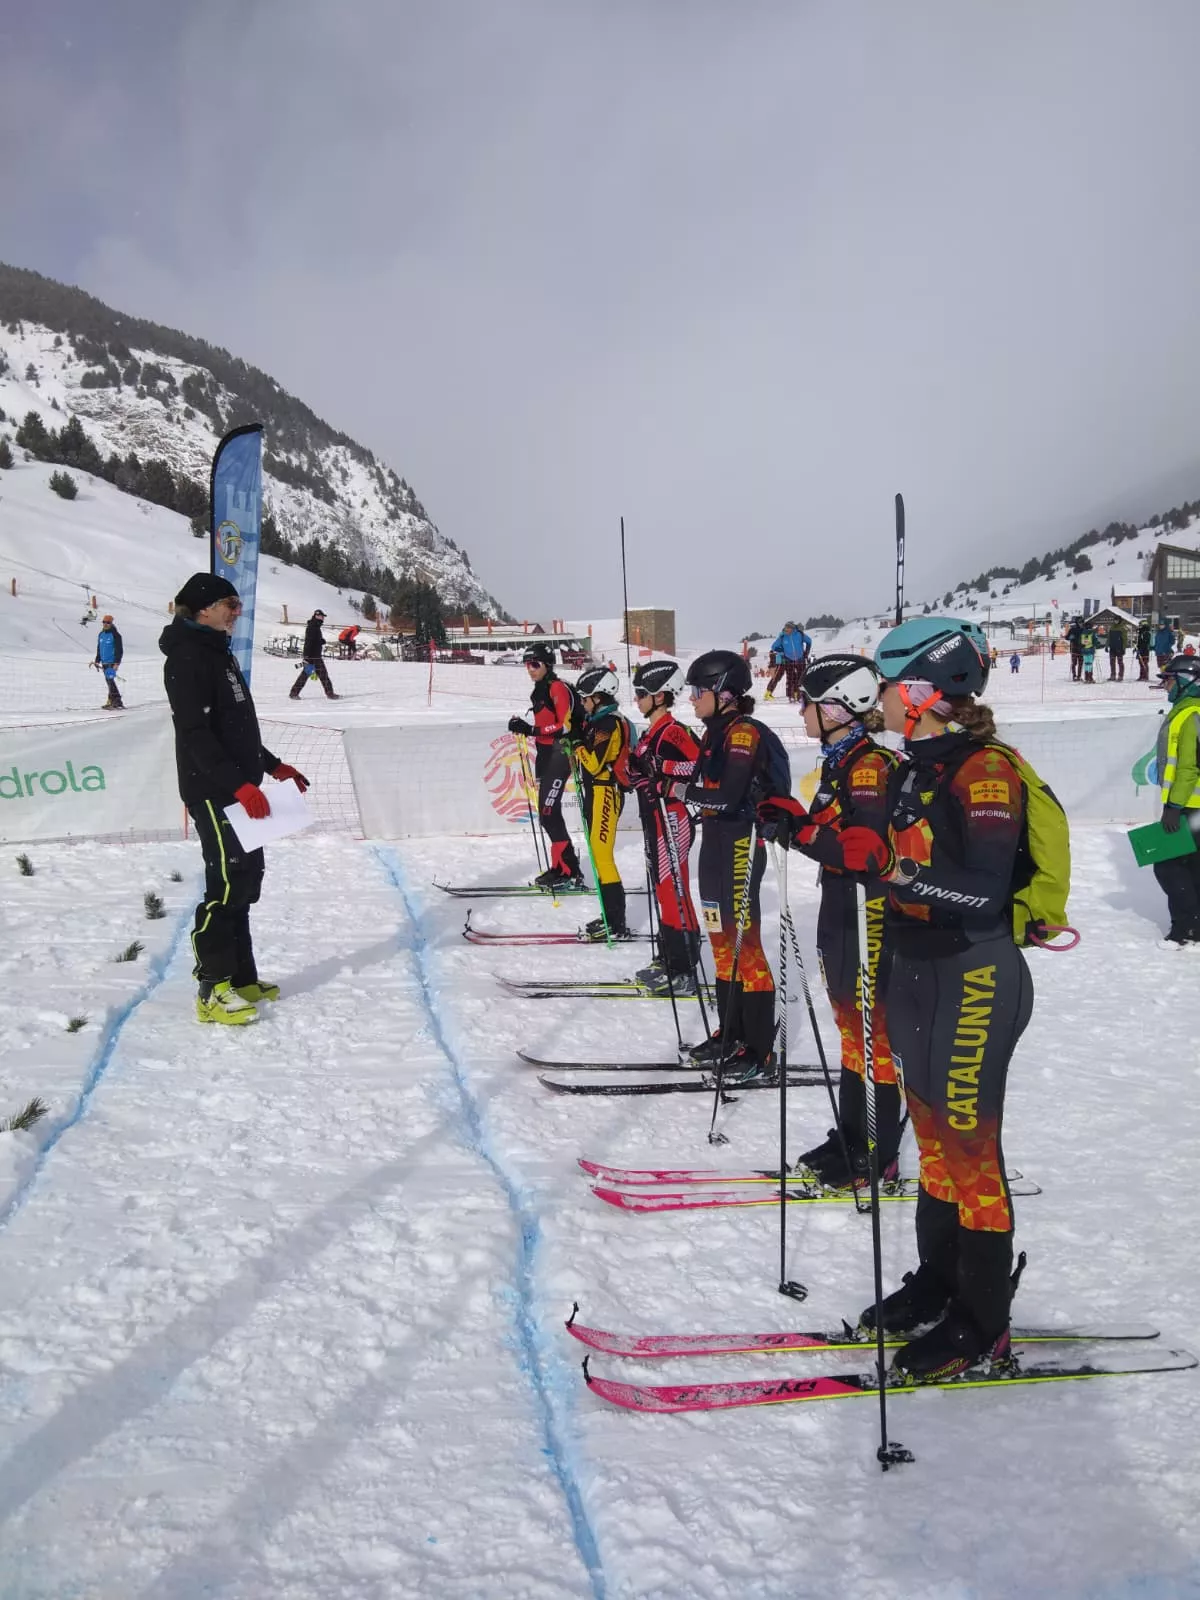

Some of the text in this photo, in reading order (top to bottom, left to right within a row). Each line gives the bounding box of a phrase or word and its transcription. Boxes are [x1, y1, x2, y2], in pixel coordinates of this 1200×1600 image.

[0, 759, 106, 799] drola
[599, 788, 614, 844] DYNAFIT
[970, 809, 1011, 820] ENFORMA
[912, 881, 990, 909] DYNAFIT
[946, 964, 997, 1132] CATALUNYA
